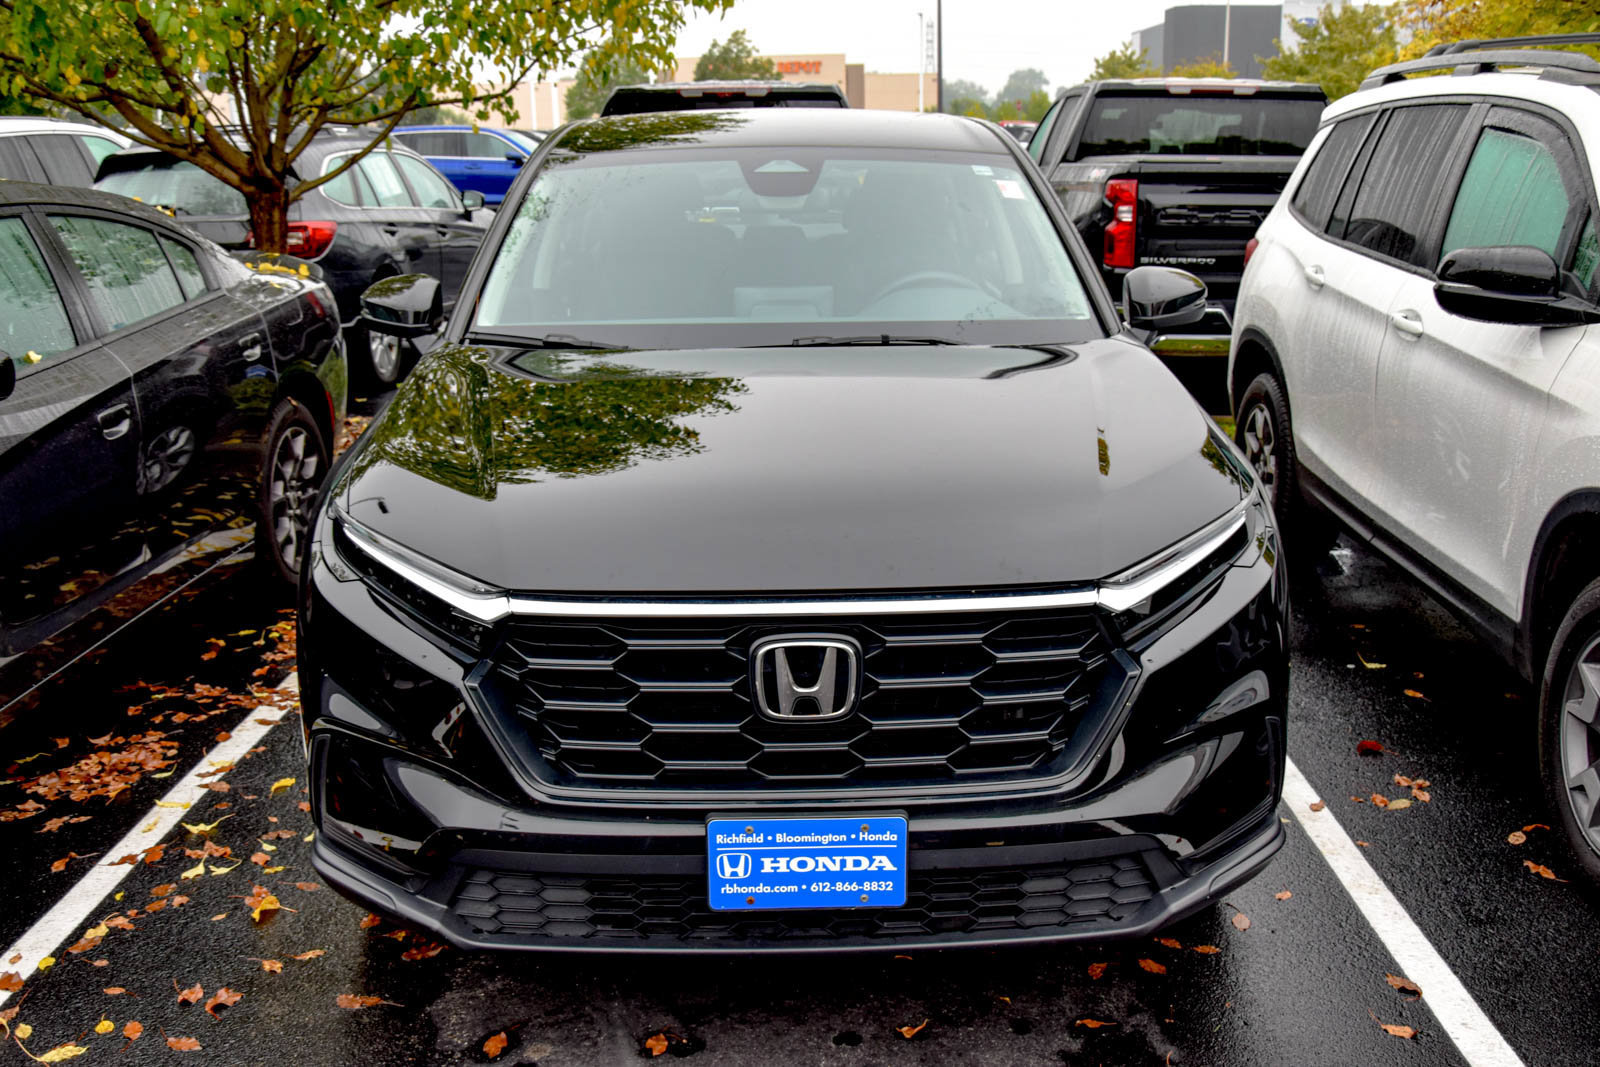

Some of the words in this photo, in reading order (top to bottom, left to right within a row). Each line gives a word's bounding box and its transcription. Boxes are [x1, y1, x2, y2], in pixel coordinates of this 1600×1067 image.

[1140, 256, 1216, 265] SILVERADO
[716, 833, 764, 844] Richfield
[775, 832, 847, 844] Bloomington
[859, 831, 898, 842] Honda
[760, 855, 898, 873] HONDA
[720, 883, 799, 894] rbhonda.com
[810, 881, 894, 892] 612-866-8832
